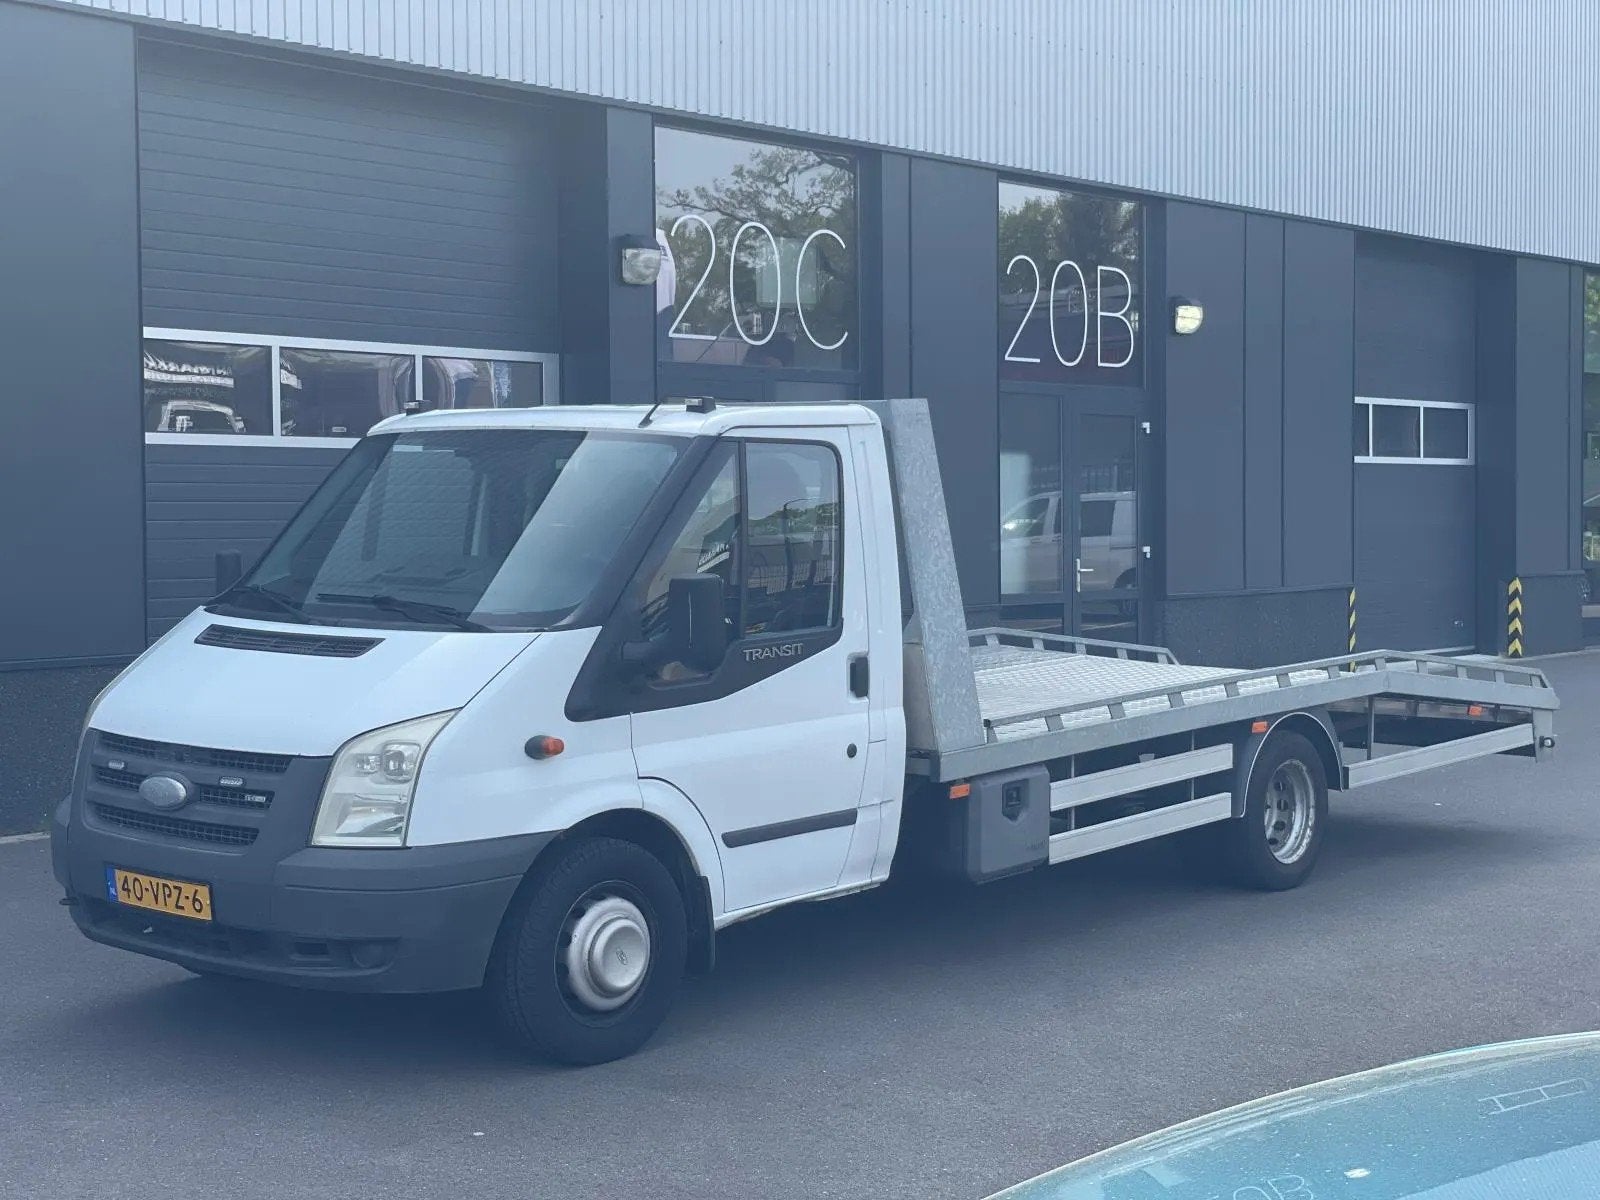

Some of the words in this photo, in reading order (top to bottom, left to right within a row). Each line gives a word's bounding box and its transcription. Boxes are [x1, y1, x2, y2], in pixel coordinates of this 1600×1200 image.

[668, 214, 848, 350] 20C
[1004, 254, 1134, 367] 20B
[742, 642, 803, 662] TRANSIT
[121, 875, 204, 913] 40-VPZ-6
